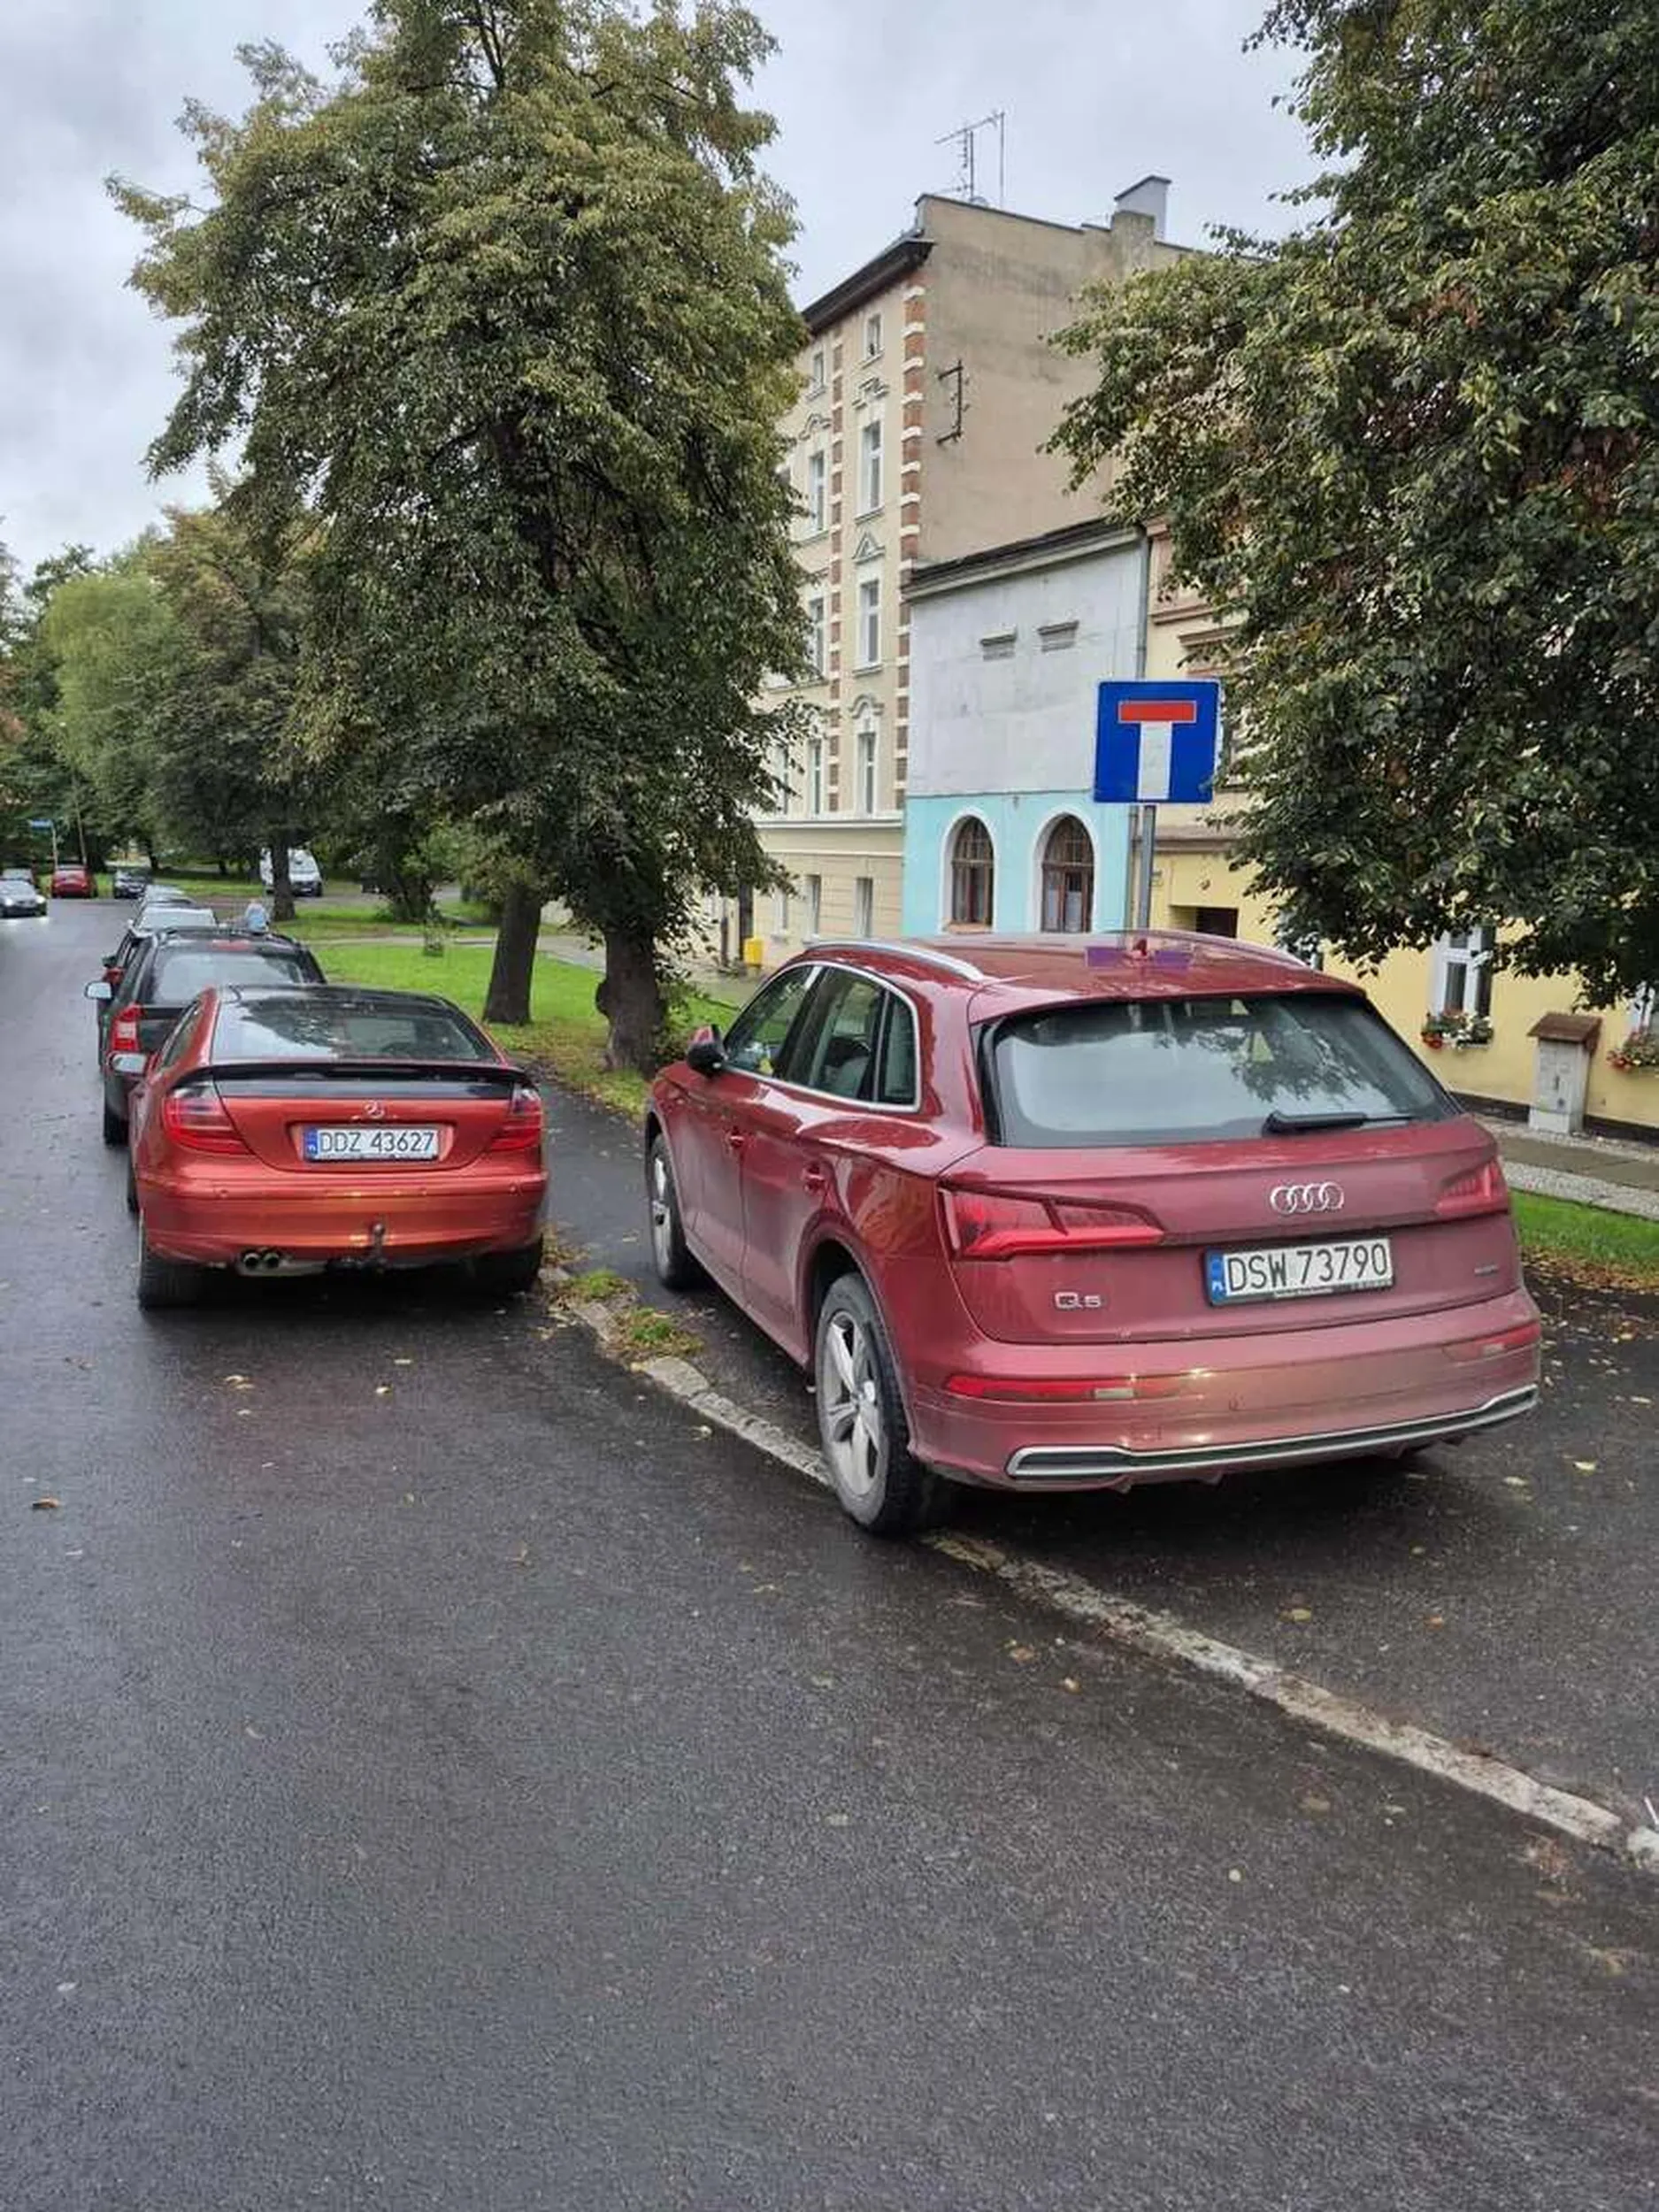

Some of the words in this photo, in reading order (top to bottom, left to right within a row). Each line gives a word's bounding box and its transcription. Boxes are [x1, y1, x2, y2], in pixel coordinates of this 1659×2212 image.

[320, 1132, 361, 1152] DDZ
[371, 1132, 434, 1152] 43627
[1227, 1253, 1287, 1292] DSW
[1295, 1243, 1388, 1285] 73790
